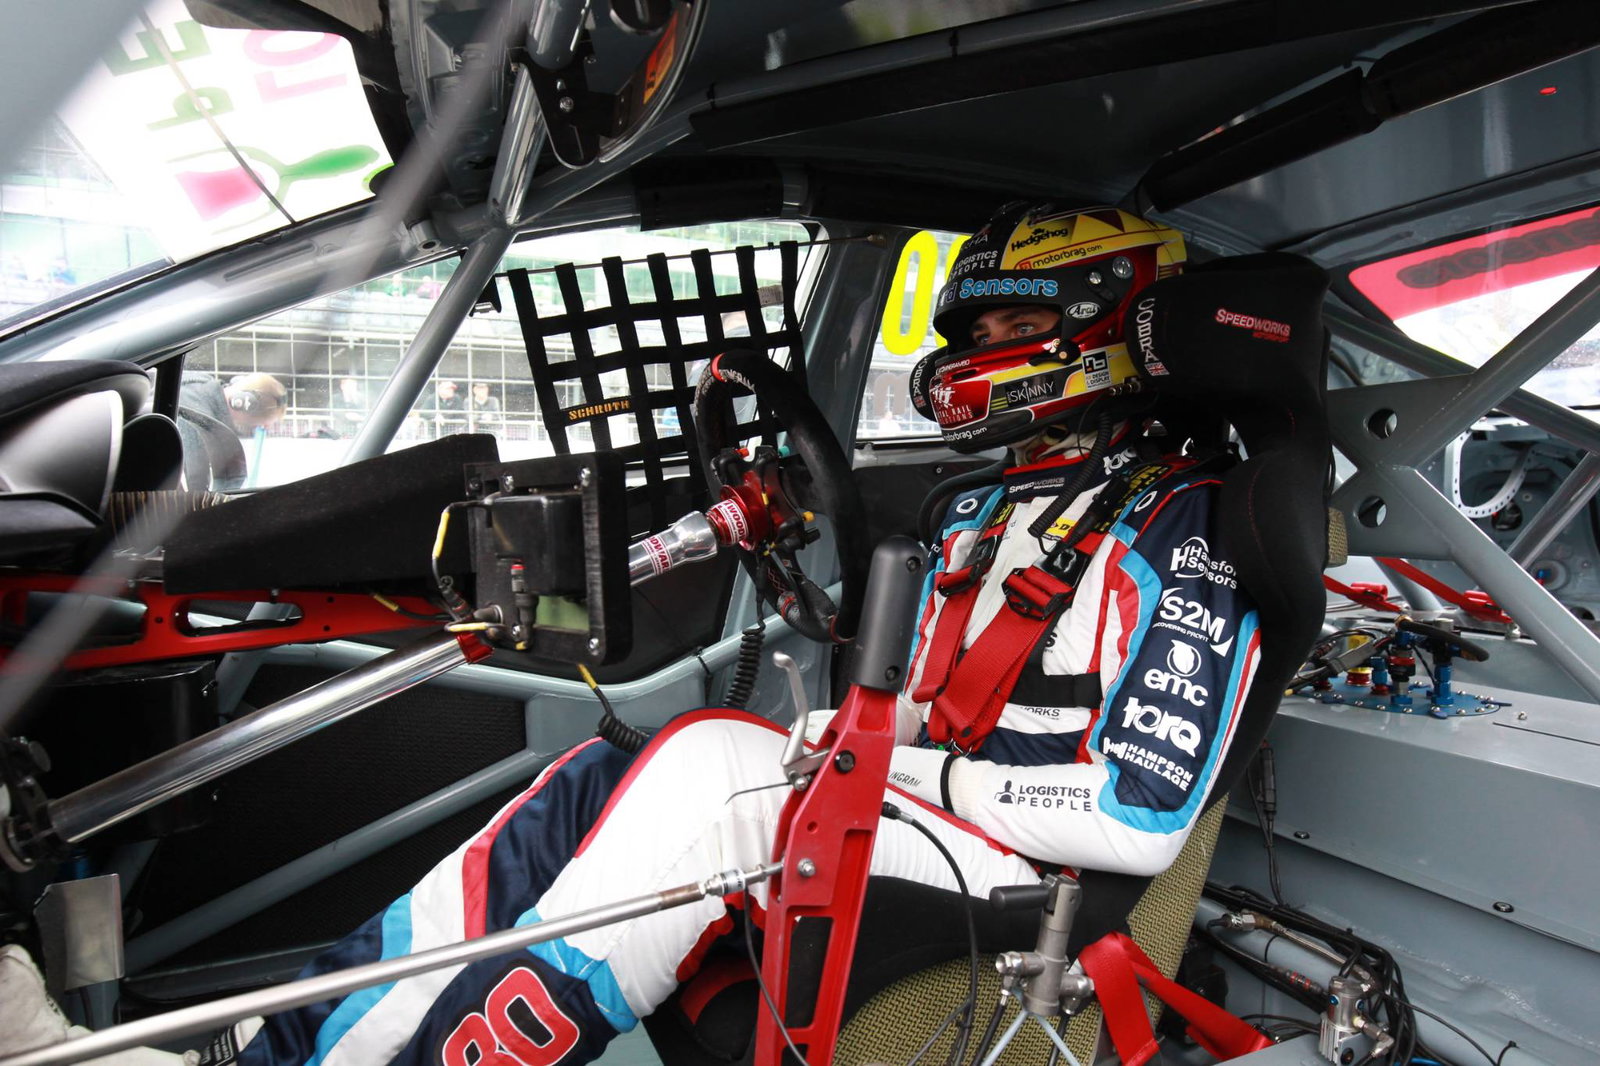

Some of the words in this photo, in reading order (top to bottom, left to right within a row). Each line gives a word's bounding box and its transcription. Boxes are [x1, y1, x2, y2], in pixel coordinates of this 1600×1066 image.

[1011, 228, 1068, 252] Hedgehog
[960, 278, 1058, 298] Sensors
[1136, 298, 1158, 362] COBRA
[1216, 308, 1290, 337] SPEEDWORKS
[1010, 381, 1054, 402] SKINNY
[568, 400, 630, 420] SCHROTH
[1186, 556, 1237, 589] Sensors
[1159, 596, 1226, 643] S2M
[1144, 668, 1209, 706] emc
[1125, 752, 1190, 792] HAULAGE
[1128, 743, 1194, 783] HAMPSON
[1017, 796, 1093, 812] PEOPLE
[1019, 784, 1092, 799] LOGISTICS
